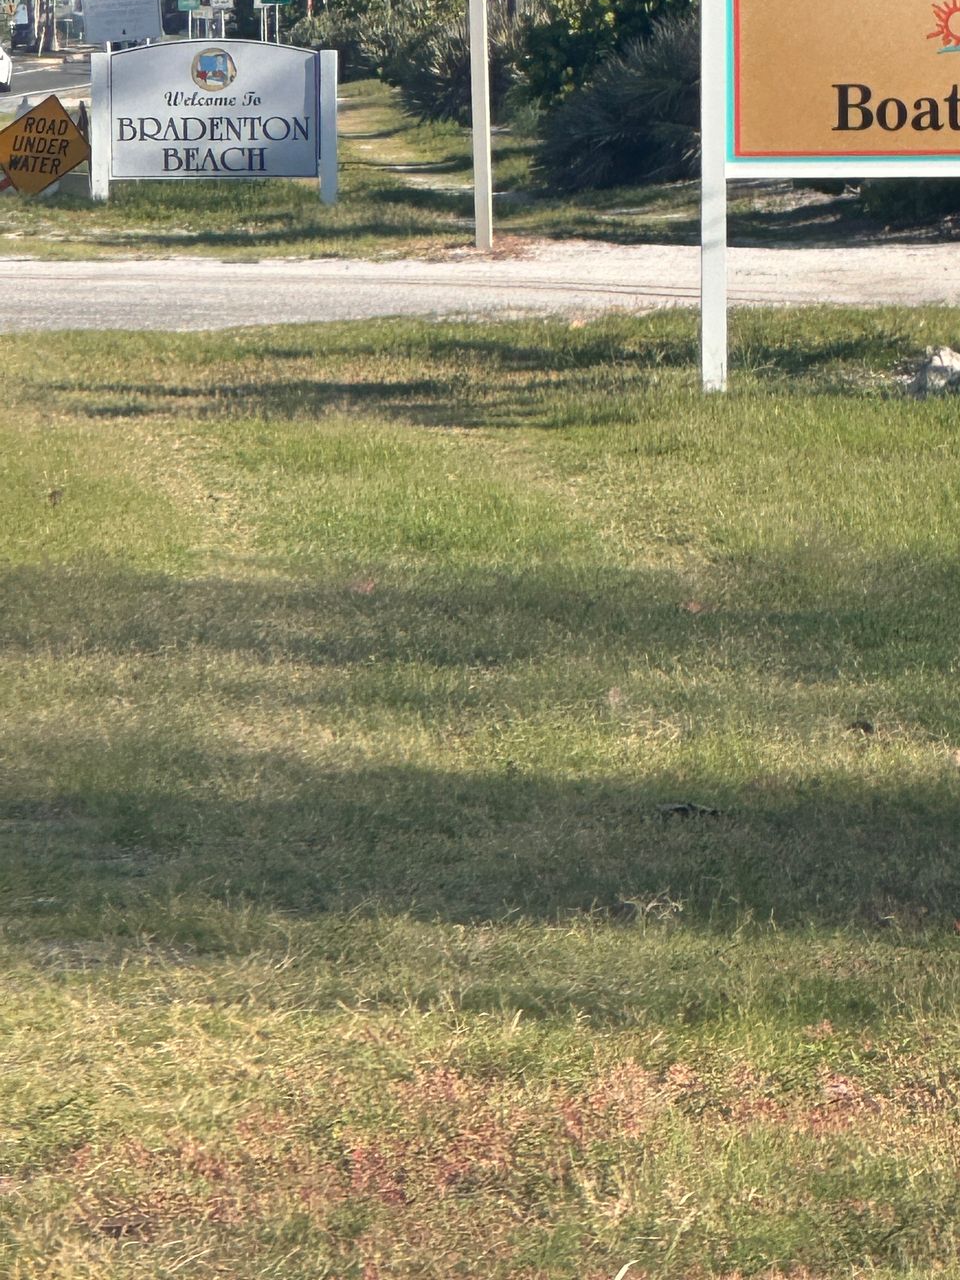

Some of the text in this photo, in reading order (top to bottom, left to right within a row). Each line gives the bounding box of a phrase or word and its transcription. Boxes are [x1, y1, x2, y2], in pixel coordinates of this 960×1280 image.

[164, 91, 262, 107] Welcome To
[24, 117, 69, 136] ROAD
[116, 116, 311, 142] BRADENTON
[12, 135, 70, 158] UNDER
[8, 153, 62, 175] WATER
[161, 147, 269, 172] BEACH
